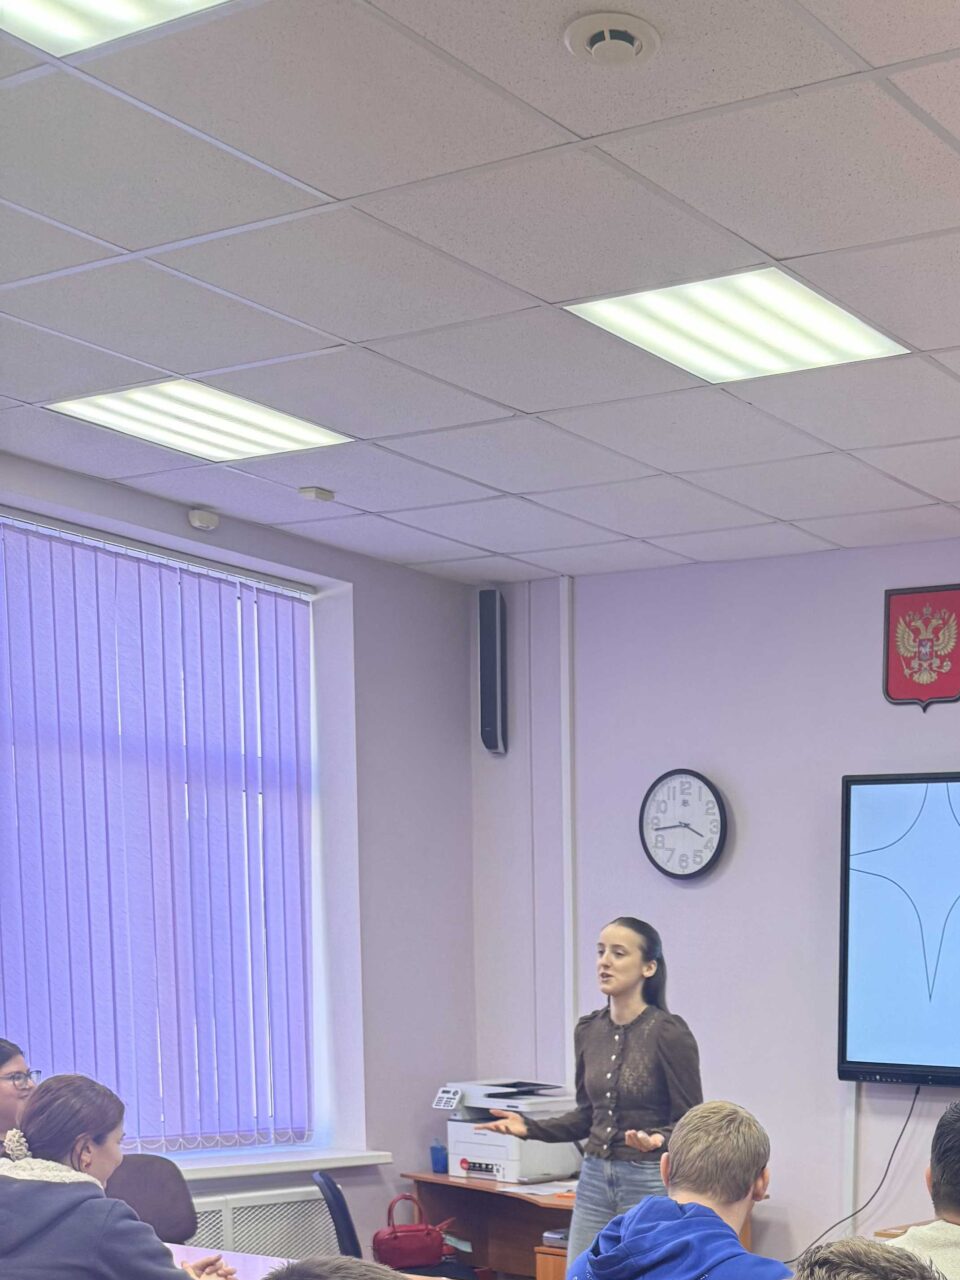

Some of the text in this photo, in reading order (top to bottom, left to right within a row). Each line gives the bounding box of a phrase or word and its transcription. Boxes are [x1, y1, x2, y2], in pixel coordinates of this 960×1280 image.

[667, 786, 677, 801] 11
[680, 781, 692, 796] 12
[656, 799, 668, 814] 10
[704, 800, 716, 816] 2
[709, 818, 720, 835] 3
[654, 834, 665, 850] 8
[703, 837, 715, 853] 4
[664, 848, 676, 864] 7
[678, 853, 690, 870] 6
[693, 849, 704, 866] 5
